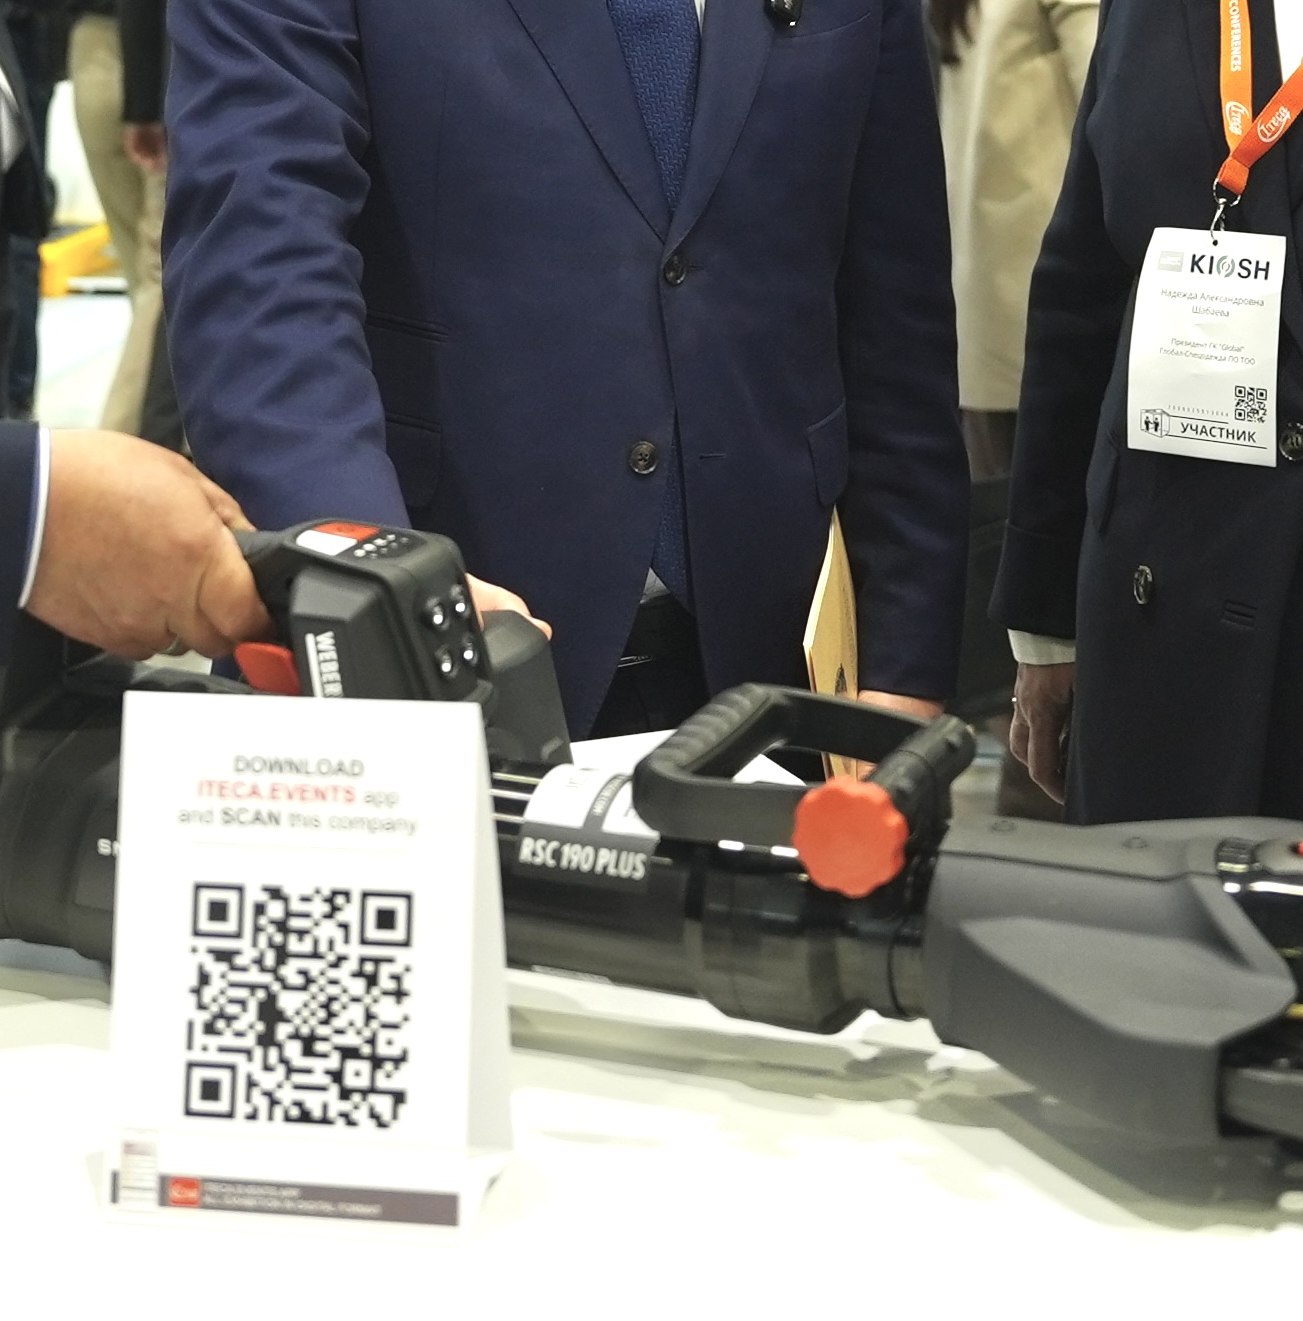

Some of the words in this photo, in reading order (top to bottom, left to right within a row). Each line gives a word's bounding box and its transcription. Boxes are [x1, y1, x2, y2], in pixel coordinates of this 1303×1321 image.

[1228, 0, 1242, 72] CONFERENCES
[1161, 288, 1197, 301] Надежда
[1241, 357, 1255, 365] ТОО
[1180, 422, 1257, 443] УЧАСТНИК
[234, 755, 364, 777] DOWNLOAD
[178, 808, 213, 824] and
[220, 807, 281, 827] SCAN
[288, 812, 321, 829] this
[328, 815, 416, 837] company
[519, 836, 560, 868] RSC
[560, 843, 596, 872] 190
[595, 847, 647, 880] PLUS
